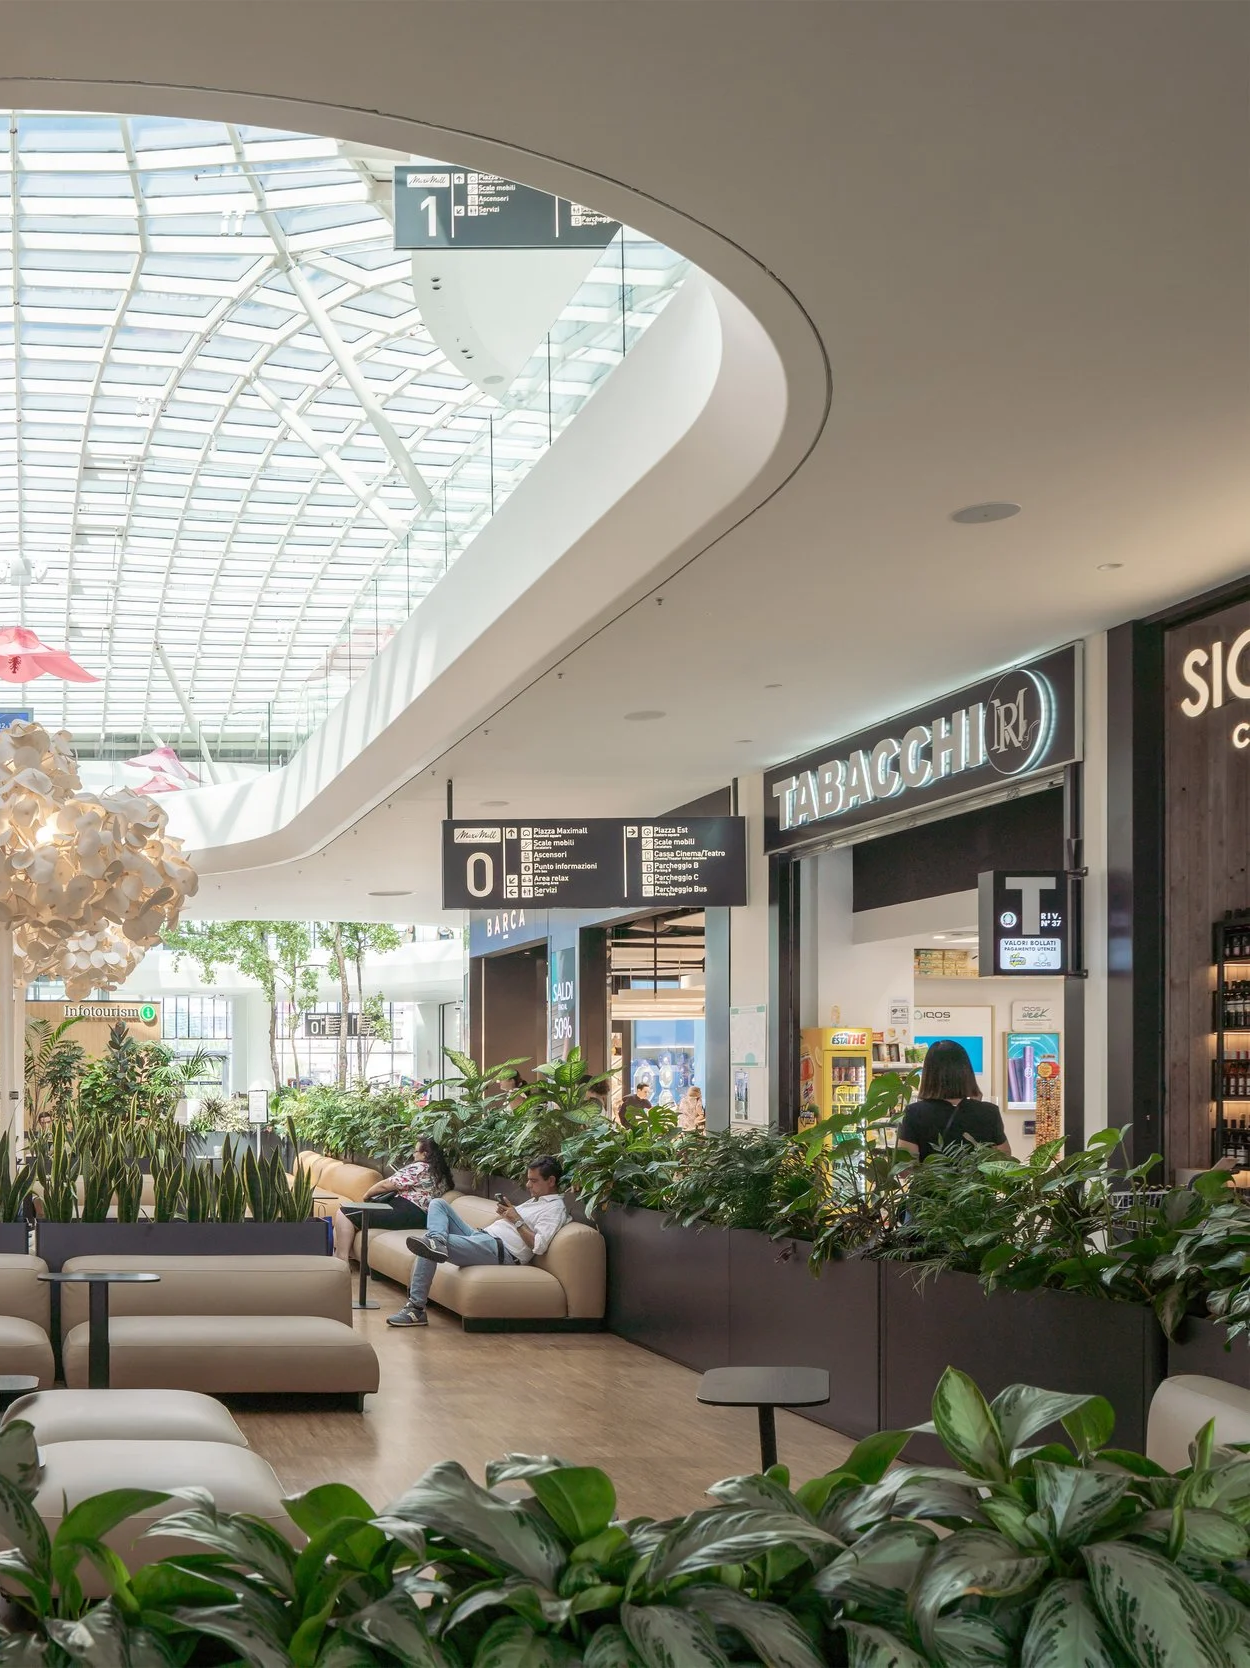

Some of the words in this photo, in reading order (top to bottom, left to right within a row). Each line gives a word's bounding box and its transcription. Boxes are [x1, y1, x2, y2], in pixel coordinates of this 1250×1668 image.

[420, 196, 437, 237] 1
[772, 702, 986, 832] TABACCHI
[675, 849, 725, 857] Cinema/Teatro
[555, 862, 597, 870] informazioni
[654, 862, 692, 870] Parcheggio
[466, 852, 494, 898] 0
[655, 874, 692, 882] Parcheggio
[534, 886, 557, 894] Servizi
[655, 885, 693, 894] Parcheggio
[693, 885, 707, 893] Bus
[1005, 876, 1057, 936] T
[486, 908, 526, 938] BARCA
[552, 980, 574, 1002] SALDI
[64, 1005, 139, 1018] Infotourism
[923, 1011, 951, 1020] IQOS
[310, 1021, 319, 1034] 0
[554, 1016, 573, 1040] 50%
